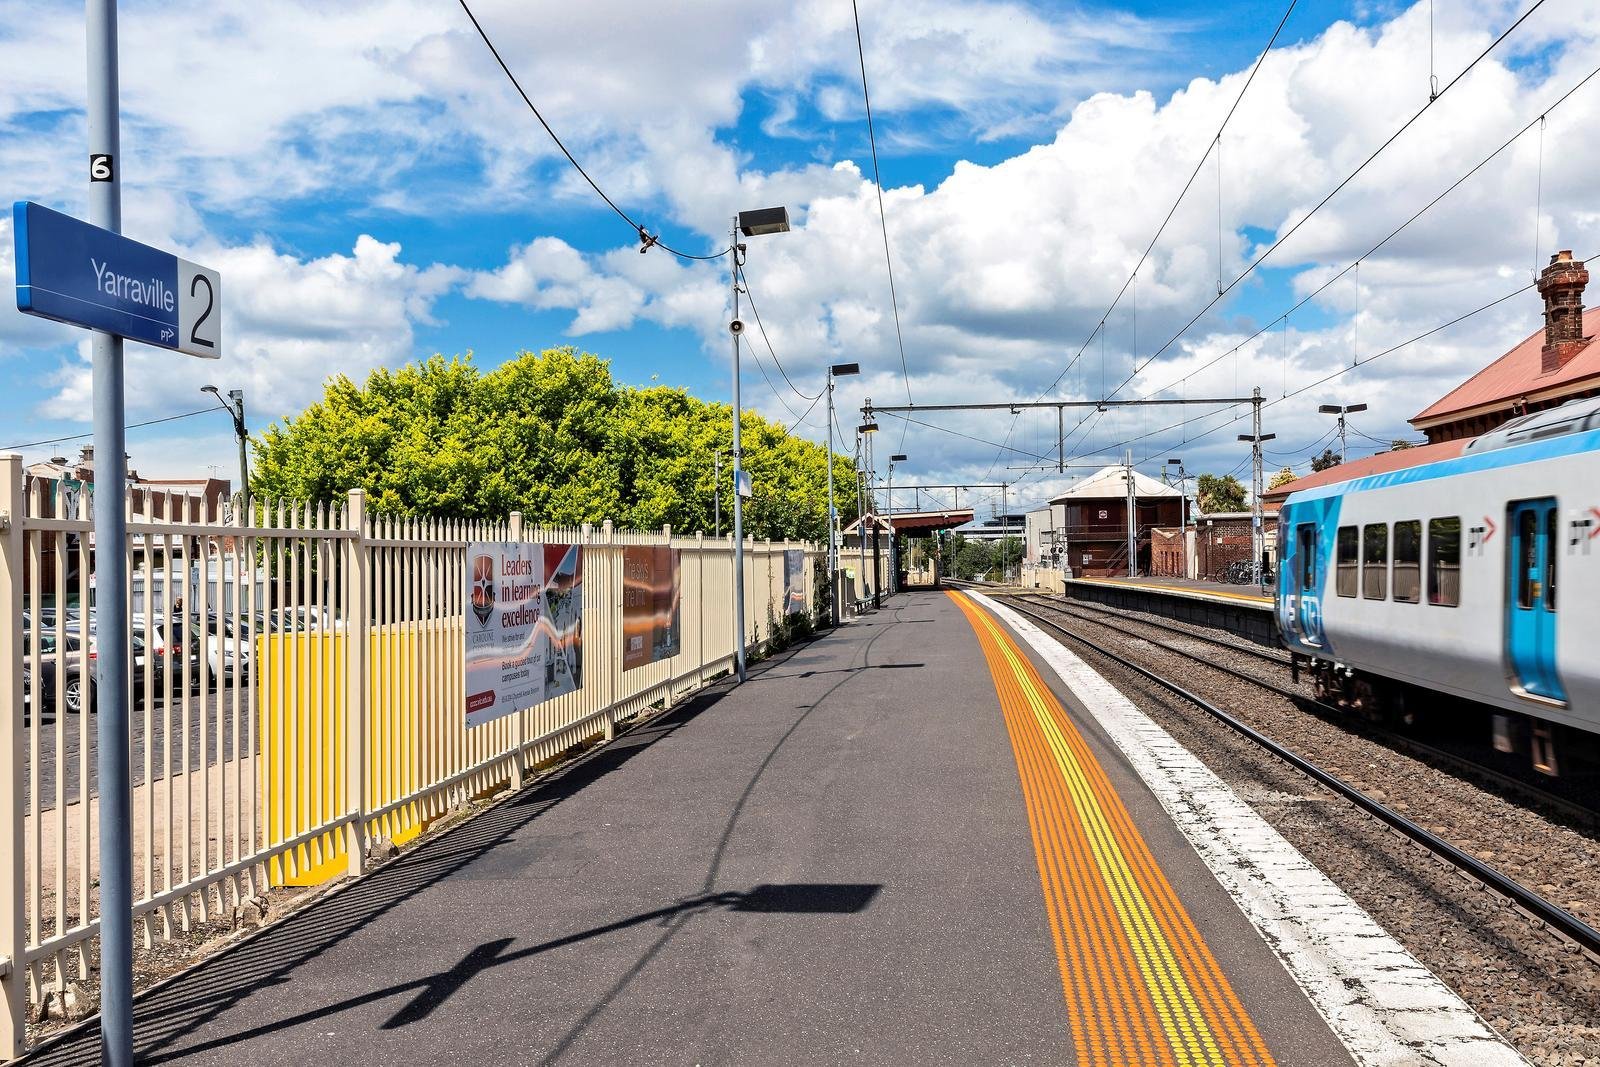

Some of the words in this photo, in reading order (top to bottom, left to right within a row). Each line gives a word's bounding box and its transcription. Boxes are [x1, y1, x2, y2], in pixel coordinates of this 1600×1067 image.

[91, 156, 110, 179] 6
[90, 257, 174, 313] Yarraville
[190, 273, 215, 348] 2
[501, 554, 532, 577] Leaders
[501, 580, 511, 602] in
[512, 579, 541, 605] learning
[501, 604, 540, 628] excellence
